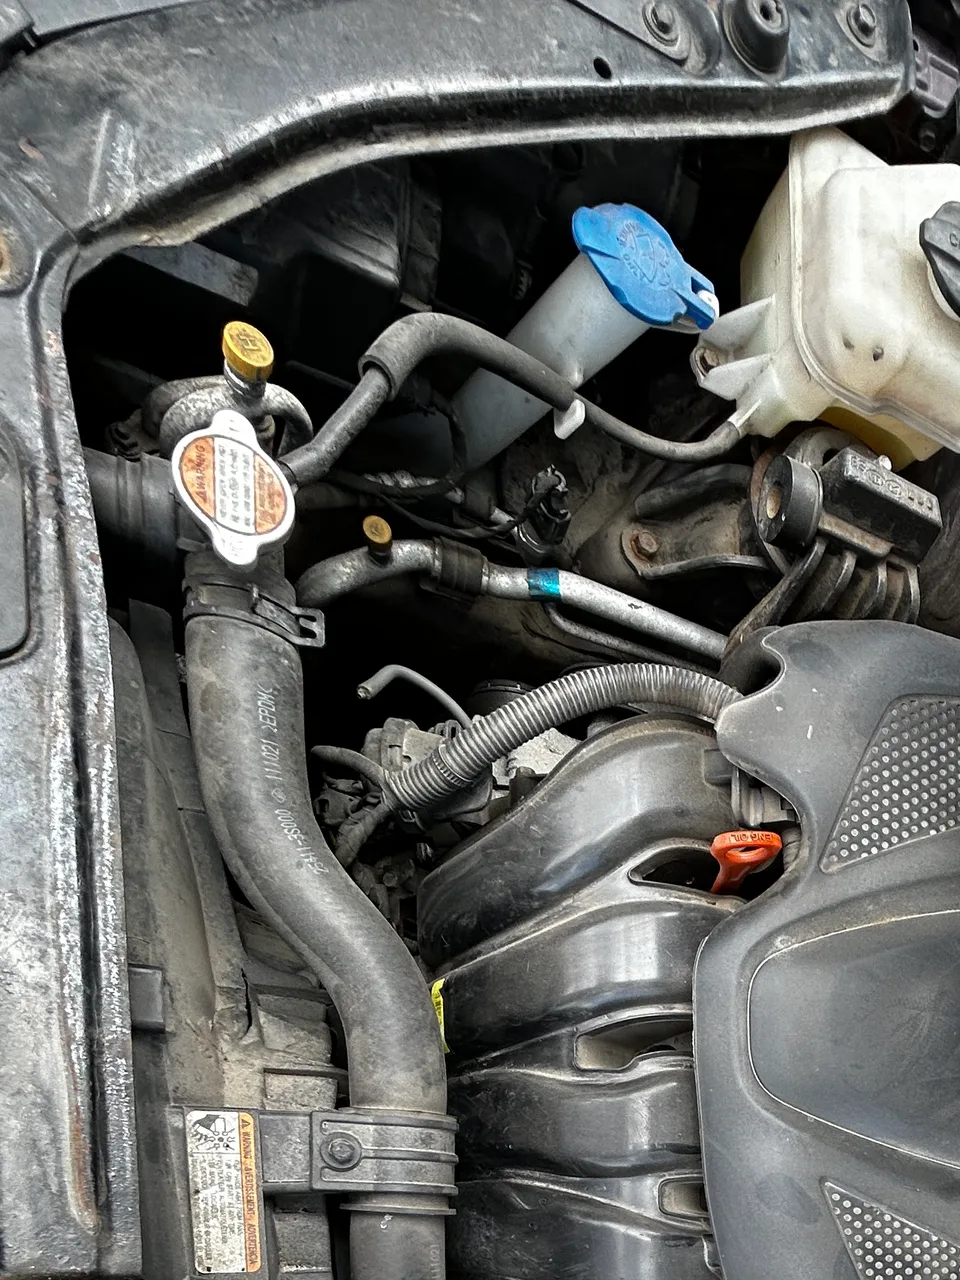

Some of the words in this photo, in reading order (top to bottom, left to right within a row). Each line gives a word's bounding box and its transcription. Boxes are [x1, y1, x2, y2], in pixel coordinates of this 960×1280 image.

[195, 444, 206, 489] WARNING
[729, 833, 749, 844] OIL
[750, 832, 774, 842] ENG
[242, 1131, 253, 1160] WARNING
[247, 1223, 259, 1265] ADVERTENCIA
[430, 1244, 440, 1279] 111021
